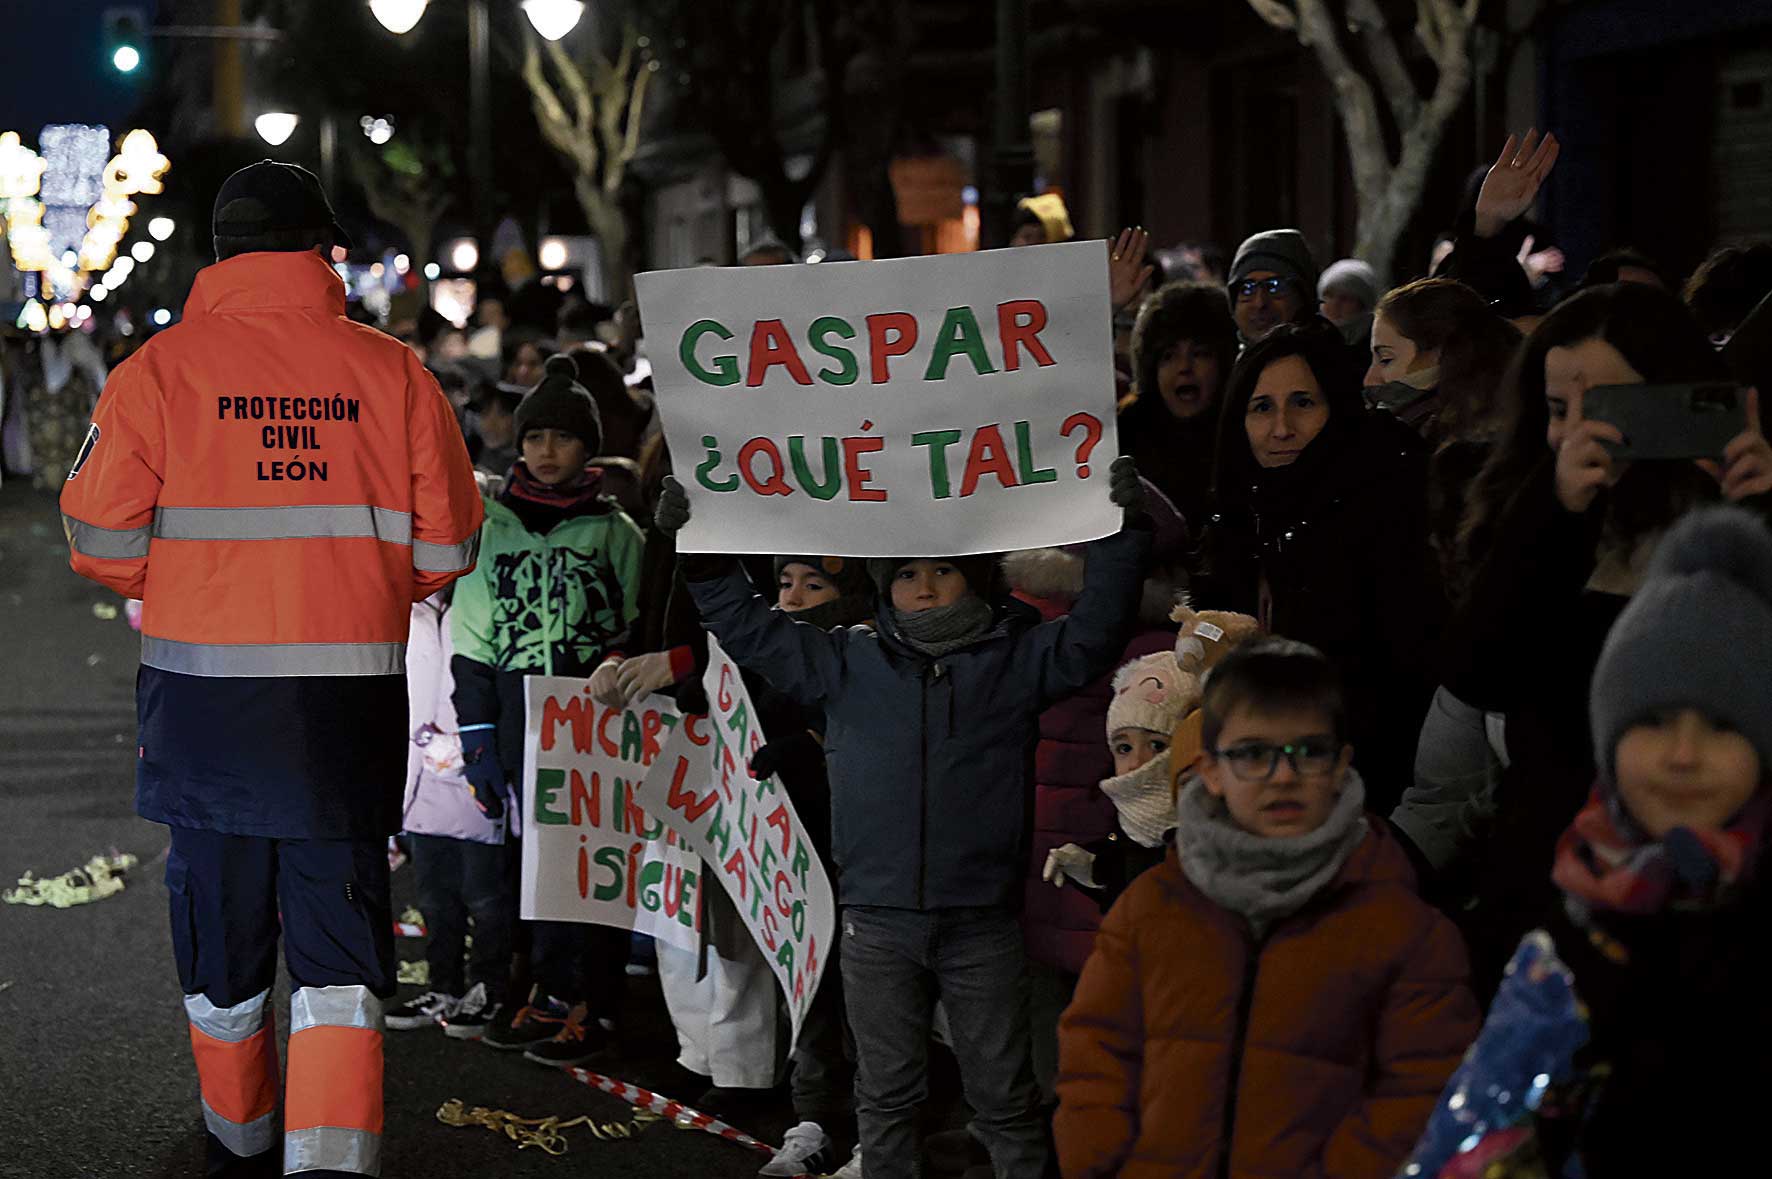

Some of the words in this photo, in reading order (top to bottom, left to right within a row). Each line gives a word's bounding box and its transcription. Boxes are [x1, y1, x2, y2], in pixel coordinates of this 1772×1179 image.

[679, 300, 1057, 387] GASPAR
[218, 393, 360, 424] PROTECCIÓN
[261, 425, 321, 450] CIVIL
[256, 455, 328, 482] LEÓN
[695, 419, 887, 502] ¿QUÉ
[911, 411, 1103, 499] TAL?
[535, 768, 601, 829] EN
[577, 834, 702, 934] ¡SÍGUE
